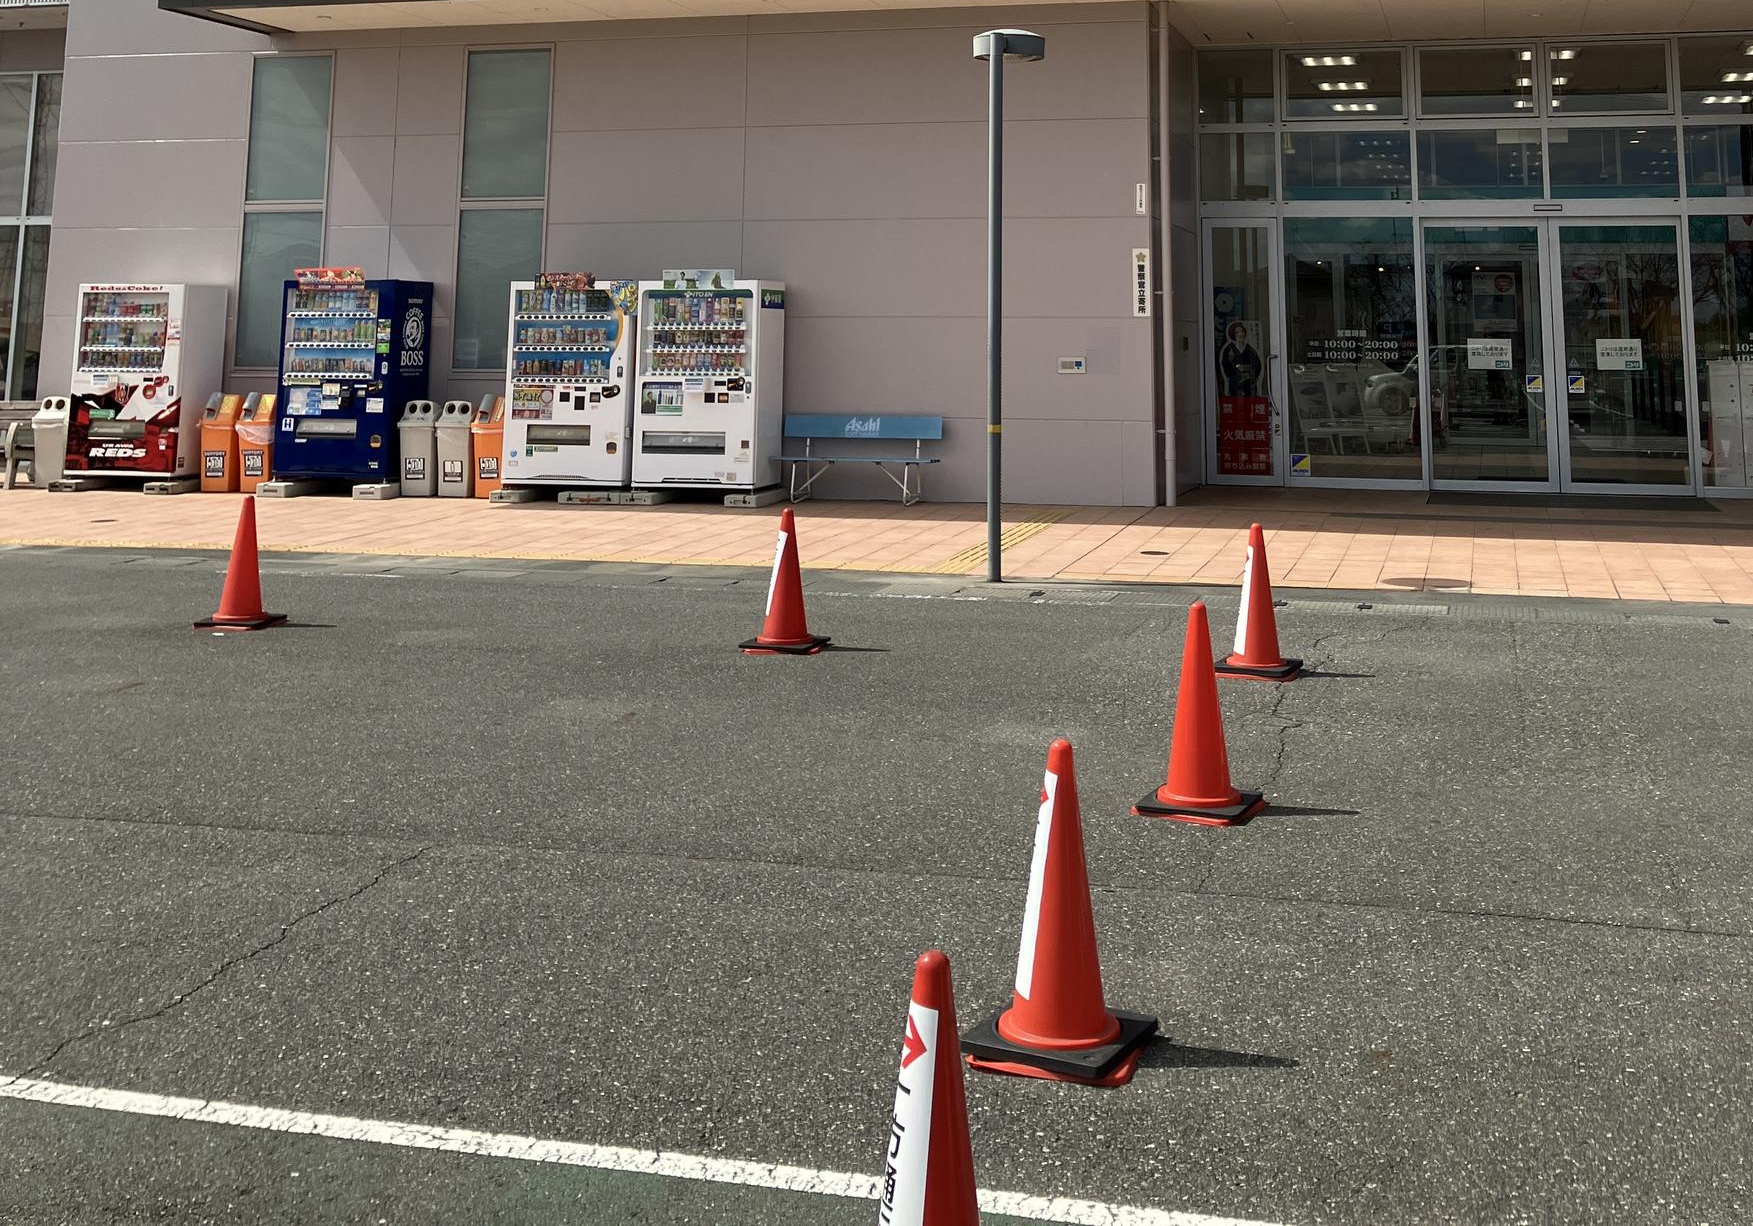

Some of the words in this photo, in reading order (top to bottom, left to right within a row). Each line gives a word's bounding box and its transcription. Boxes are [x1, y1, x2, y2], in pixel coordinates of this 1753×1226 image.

[400, 350, 424, 366] BOSS
[845, 417, 880, 432] Asahi
[89, 447, 147, 457] REDS
